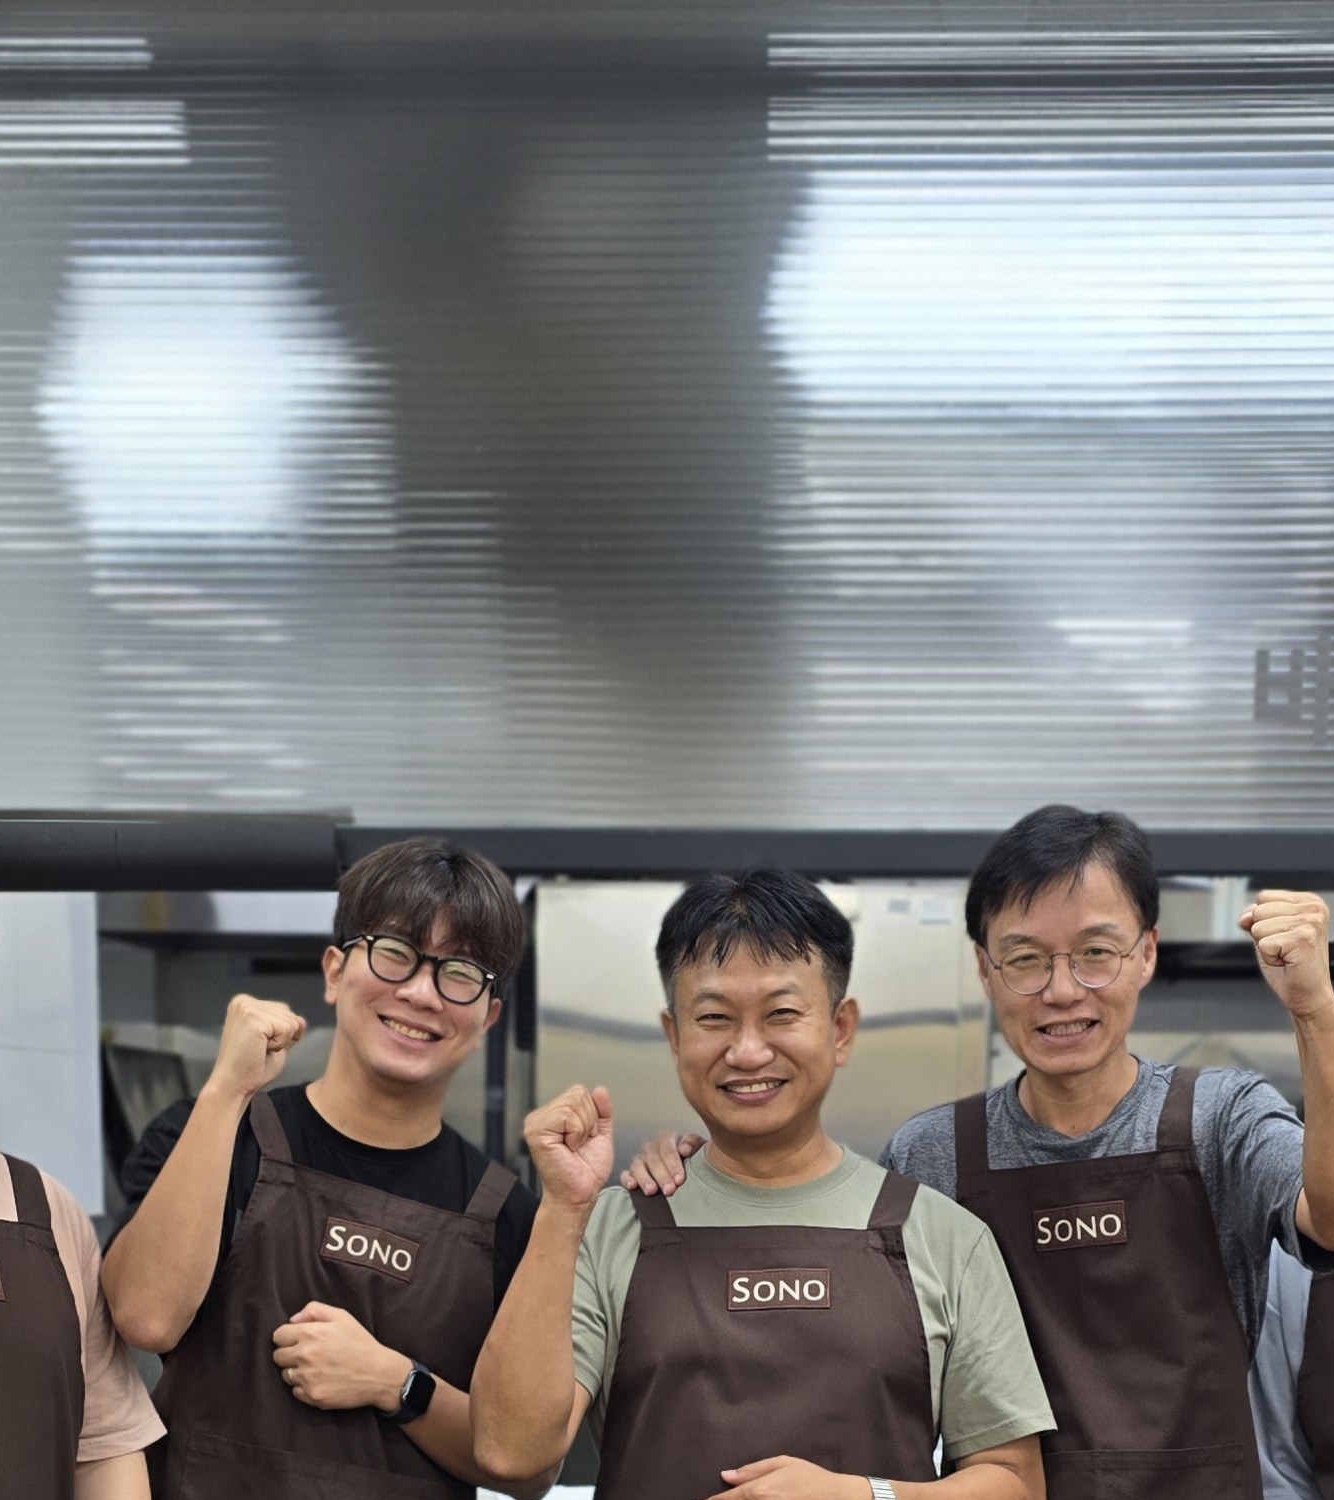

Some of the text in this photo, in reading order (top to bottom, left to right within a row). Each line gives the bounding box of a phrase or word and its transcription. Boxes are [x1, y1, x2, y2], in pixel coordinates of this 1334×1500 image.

[1037, 1213, 1122, 1245] SONO
[325, 1225, 412, 1272] SONO
[732, 1277, 827, 1303] SONO
